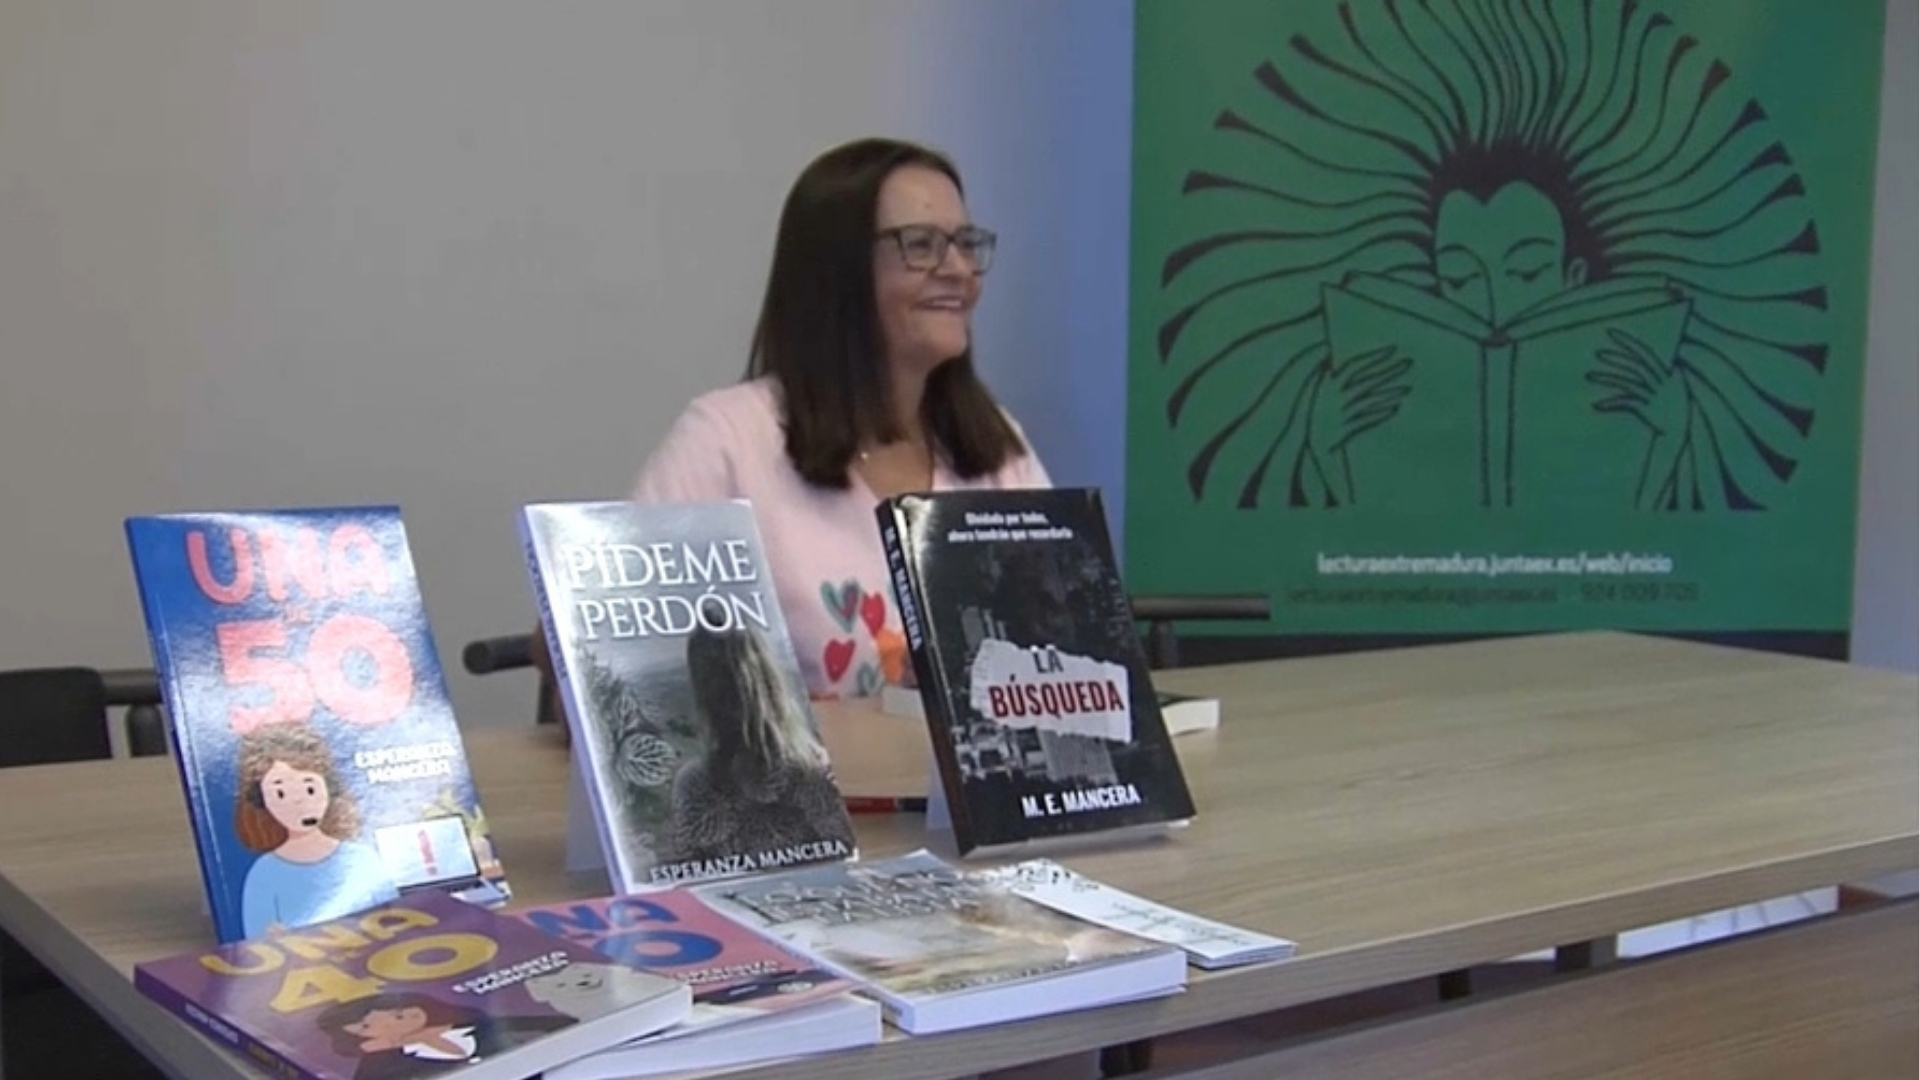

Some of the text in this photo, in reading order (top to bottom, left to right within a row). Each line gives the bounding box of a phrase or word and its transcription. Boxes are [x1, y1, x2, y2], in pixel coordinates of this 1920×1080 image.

[187, 524, 390, 607] UNA
[563, 539, 757, 589] PÍDEME
[579, 585, 769, 640] PERDÓN
[895, 567, 922, 651] MANCERA
[215, 613, 415, 734] 50
[1031, 645, 1065, 675] LA
[988, 674, 1125, 719] BÚSQUEDA
[1021, 784, 1142, 818] M. E. MANCERA
[650, 840, 848, 884] ESPERANZA MANCERA
[200, 908, 440, 977] UNA
[526, 897, 680, 936] NA
[269, 933, 499, 1013] 40
